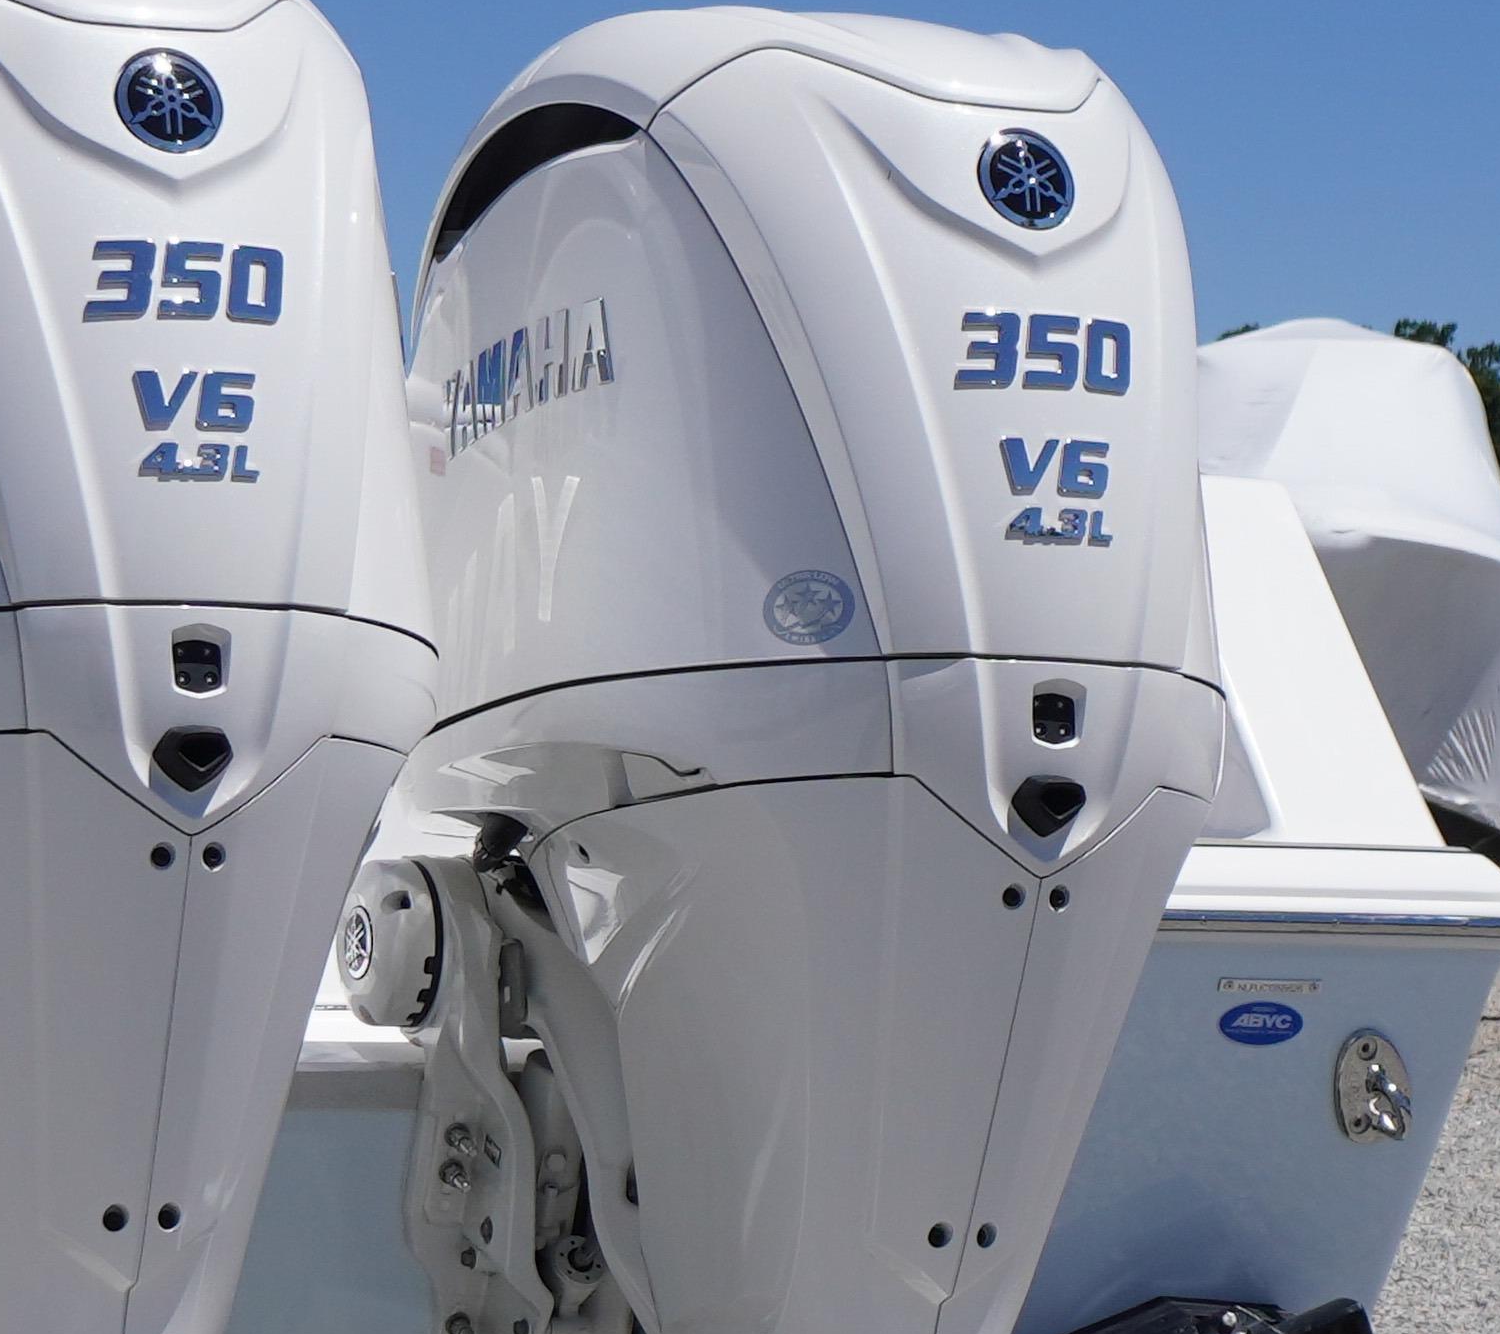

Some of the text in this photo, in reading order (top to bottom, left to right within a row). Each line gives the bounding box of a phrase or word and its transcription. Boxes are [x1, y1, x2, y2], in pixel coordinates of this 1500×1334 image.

[83, 239, 284, 326] 350
[443, 296, 614, 461] YAMAHA
[954, 312, 1131, 397] 350
[132, 369, 256, 433] V6
[137, 442, 260, 484] 4.3L
[999, 436, 1110, 500] V6
[1004, 507, 1113, 548] 4.3L
